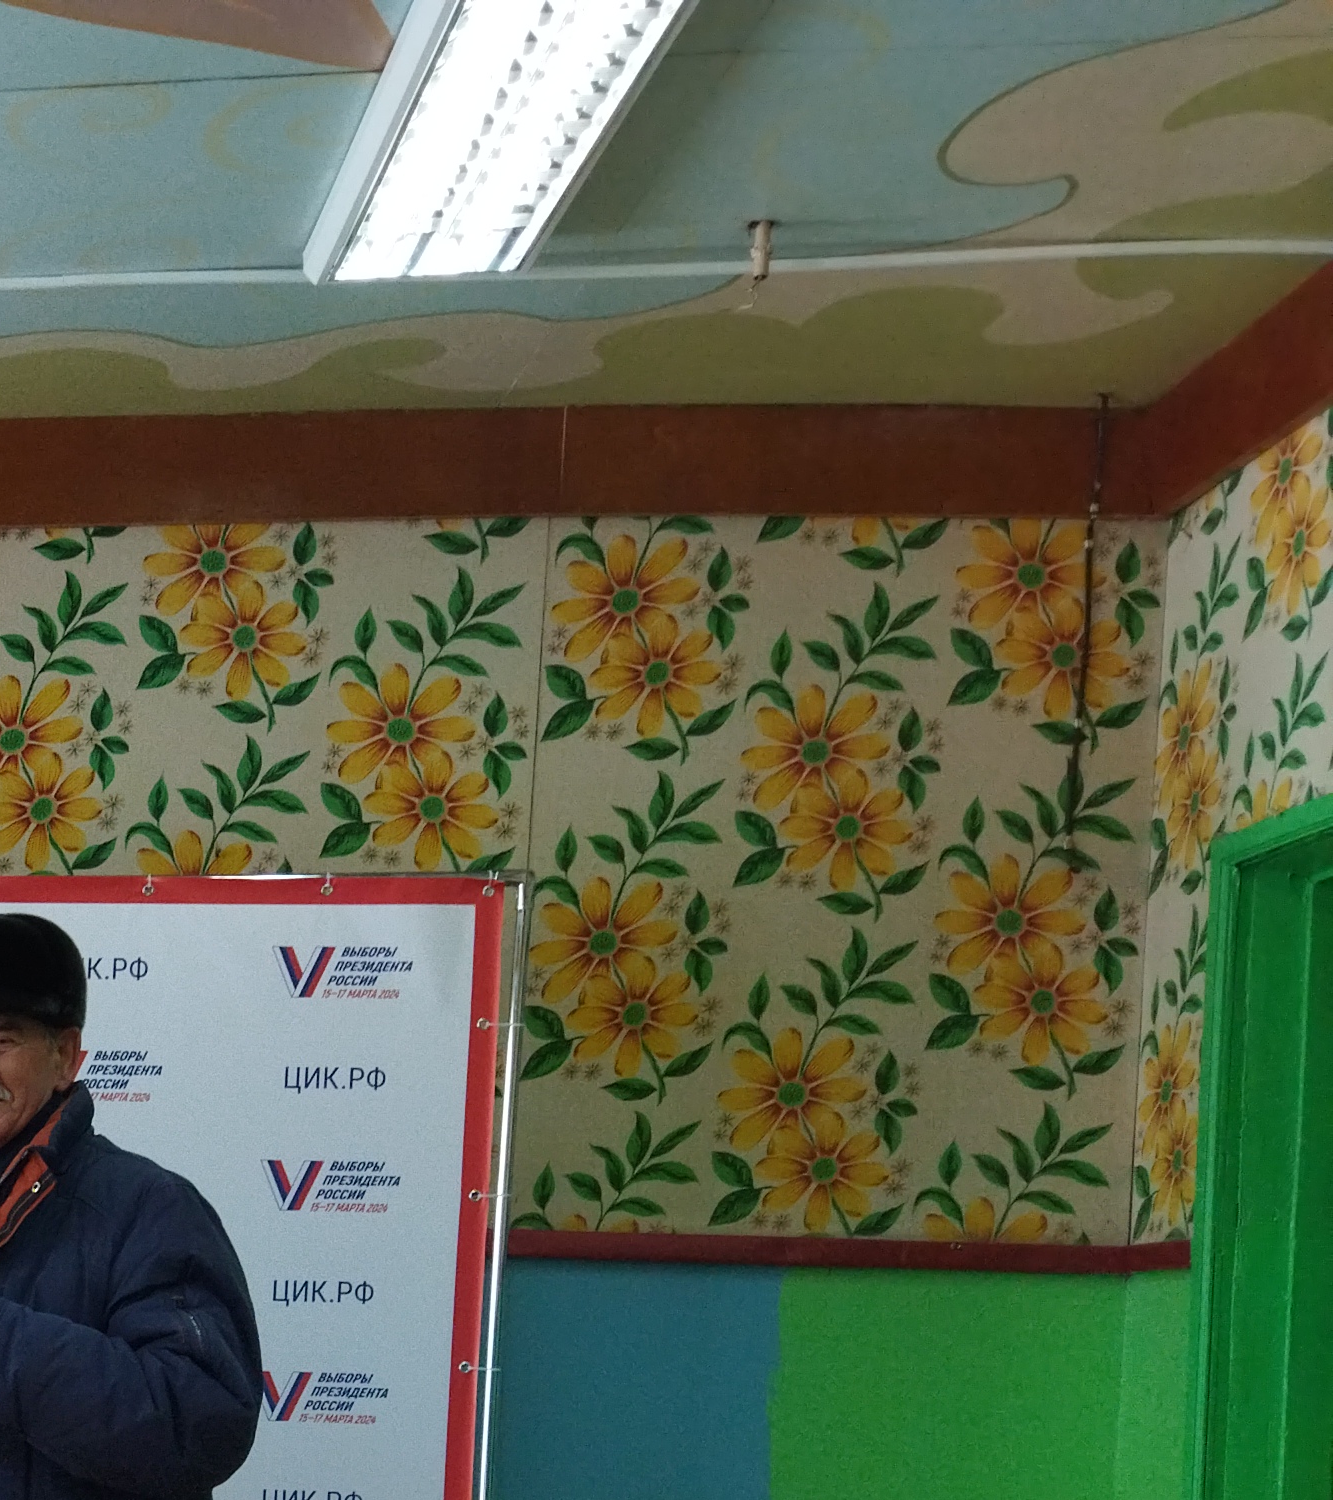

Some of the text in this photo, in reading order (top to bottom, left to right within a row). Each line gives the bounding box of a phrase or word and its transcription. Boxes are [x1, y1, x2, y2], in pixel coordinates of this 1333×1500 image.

[341, 946, 398, 958] ВЫБОРЫ
[82, 956, 148, 981] К.РФ
[334, 961, 413, 973] ПРЕЗИДЕНТА
[326, 975, 378, 986] РОССИИ
[347, 989, 378, 999] МАРТА
[378, 990, 400, 999] 2024
[94, 1050, 148, 1061] ВЫБОРЫ
[87, 1065, 163, 1077] ПРЕЗИДЕНТА
[285, 1067, 385, 1094] ЦИК.РФ
[100, 1092, 130, 1102] МАРТА
[130, 1093, 151, 1102] 2024
[329, 1161, 386, 1173] ВЫБОРЫ
[322, 1175, 401, 1187] ПРЕЗИДЕНТА
[315, 1189, 366, 1200] РОССИИ
[335, 1203, 367, 1212] МАРТА
[366, 1204, 388, 1213] 2024
[273, 1280, 373, 1307] ЦИК.РФ
[318, 1372, 374, 1384] ВЫБОРЫ
[310, 1386, 389, 1399] ПРЕЗИДЕНТА
[303, 1400, 354, 1412] РОССИИ
[324, 1414, 355, 1424] МАРТА
[354, 1415, 377, 1425] 2024
